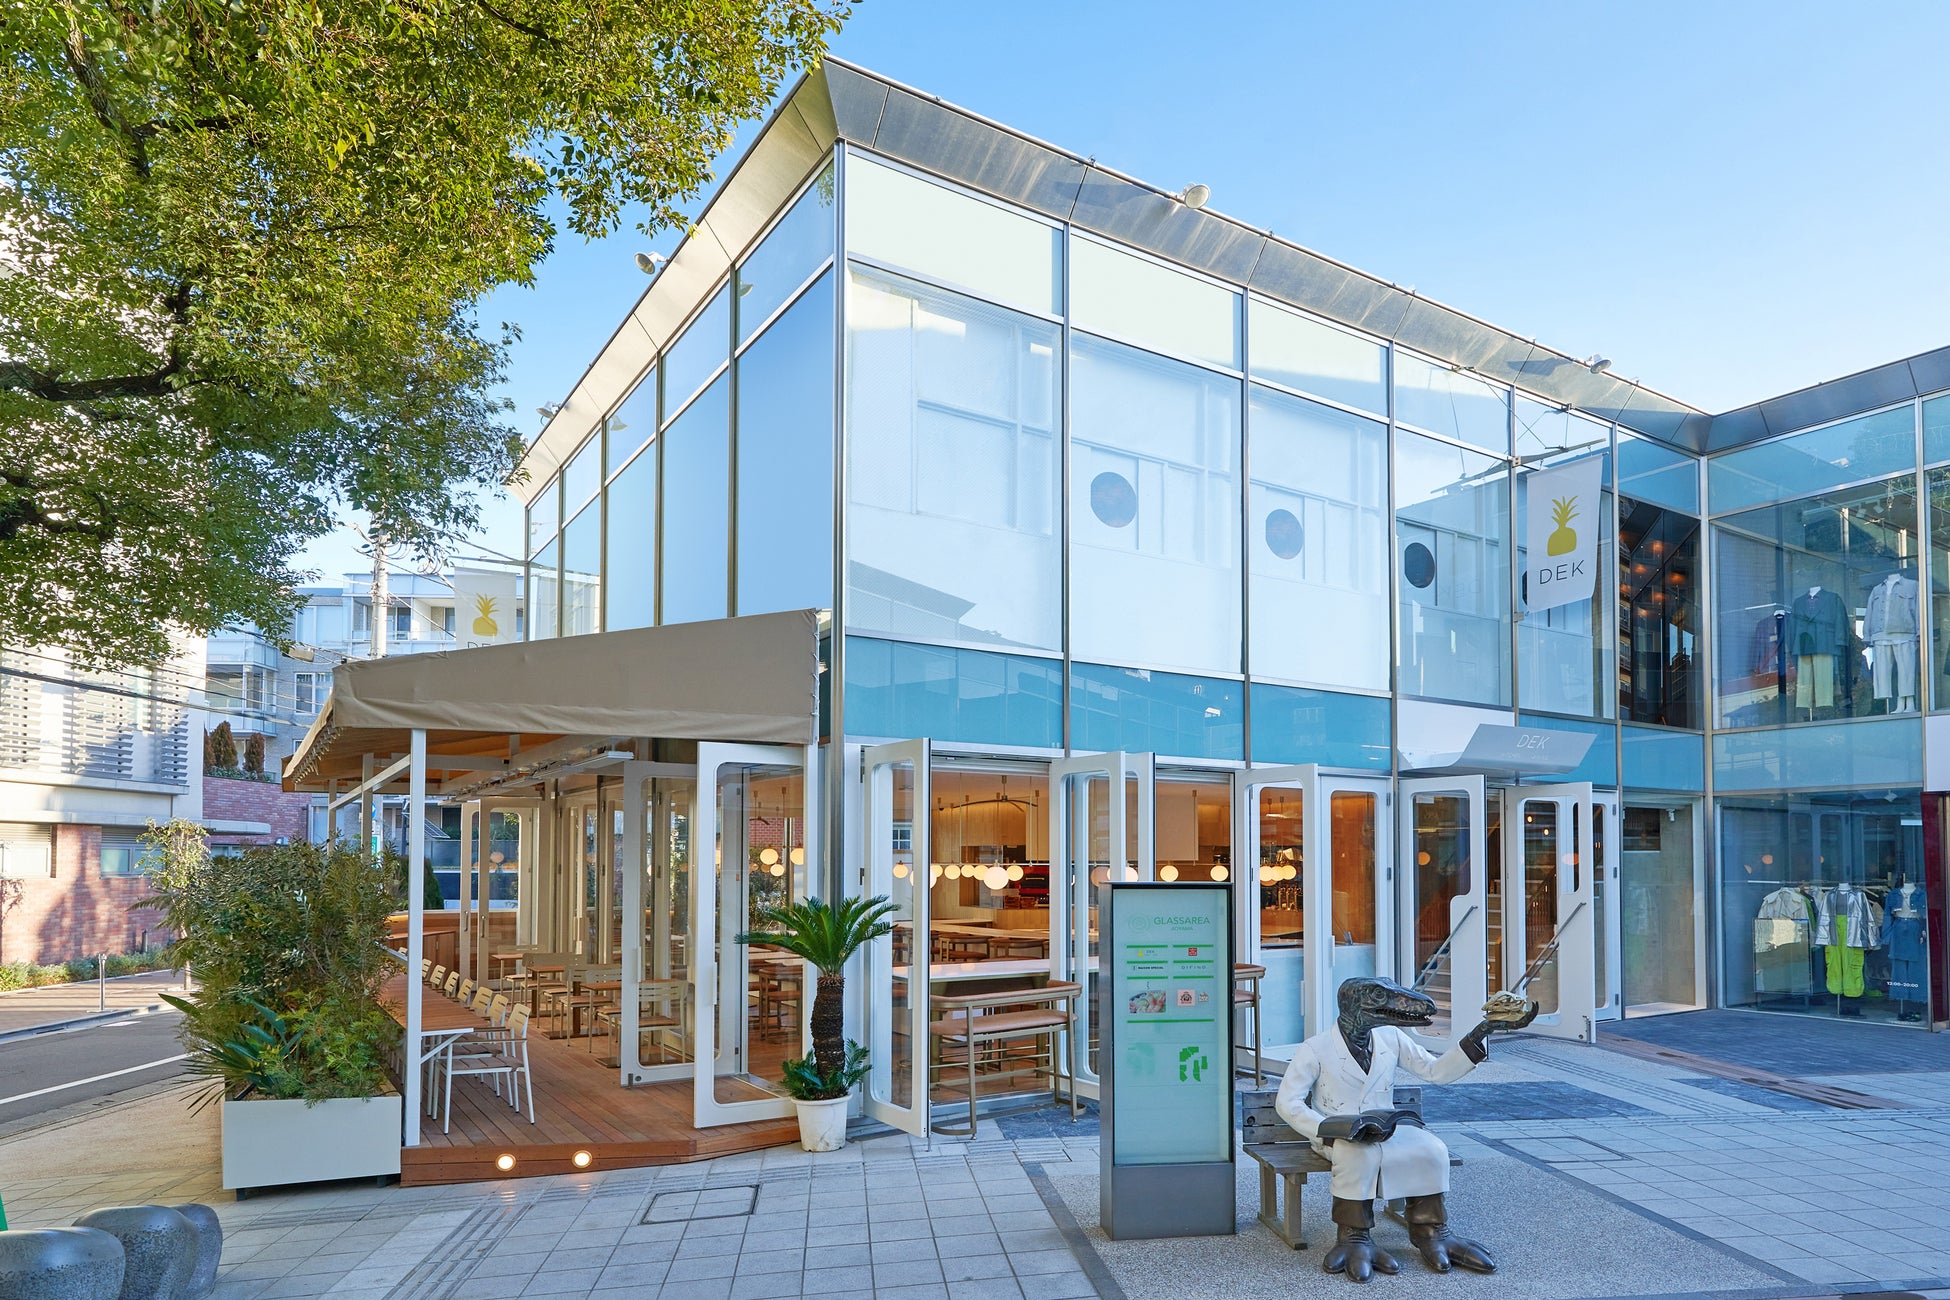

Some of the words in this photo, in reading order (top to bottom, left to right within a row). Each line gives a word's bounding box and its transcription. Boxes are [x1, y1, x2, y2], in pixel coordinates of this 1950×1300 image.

[1539, 559, 1585, 585] DEK
[1516, 734, 1551, 749] DEK
[1153, 916, 1210, 925] GLASSAREA
